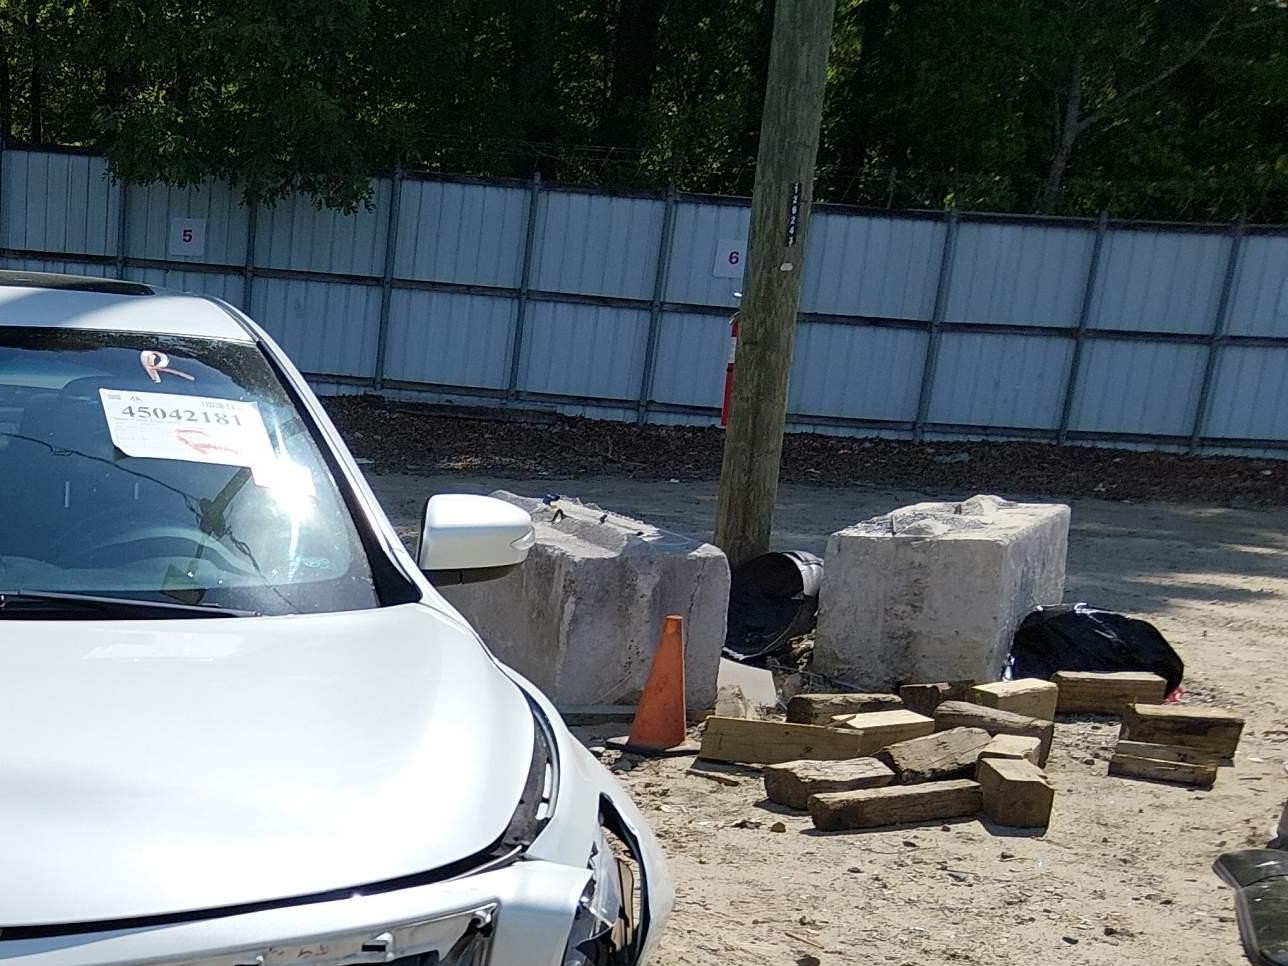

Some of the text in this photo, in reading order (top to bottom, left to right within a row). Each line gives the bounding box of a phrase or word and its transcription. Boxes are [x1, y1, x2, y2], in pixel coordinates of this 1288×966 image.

[182, 229, 194, 243] 5
[728, 250, 740, 265] 6
[121, 404, 243, 427] 45042181
